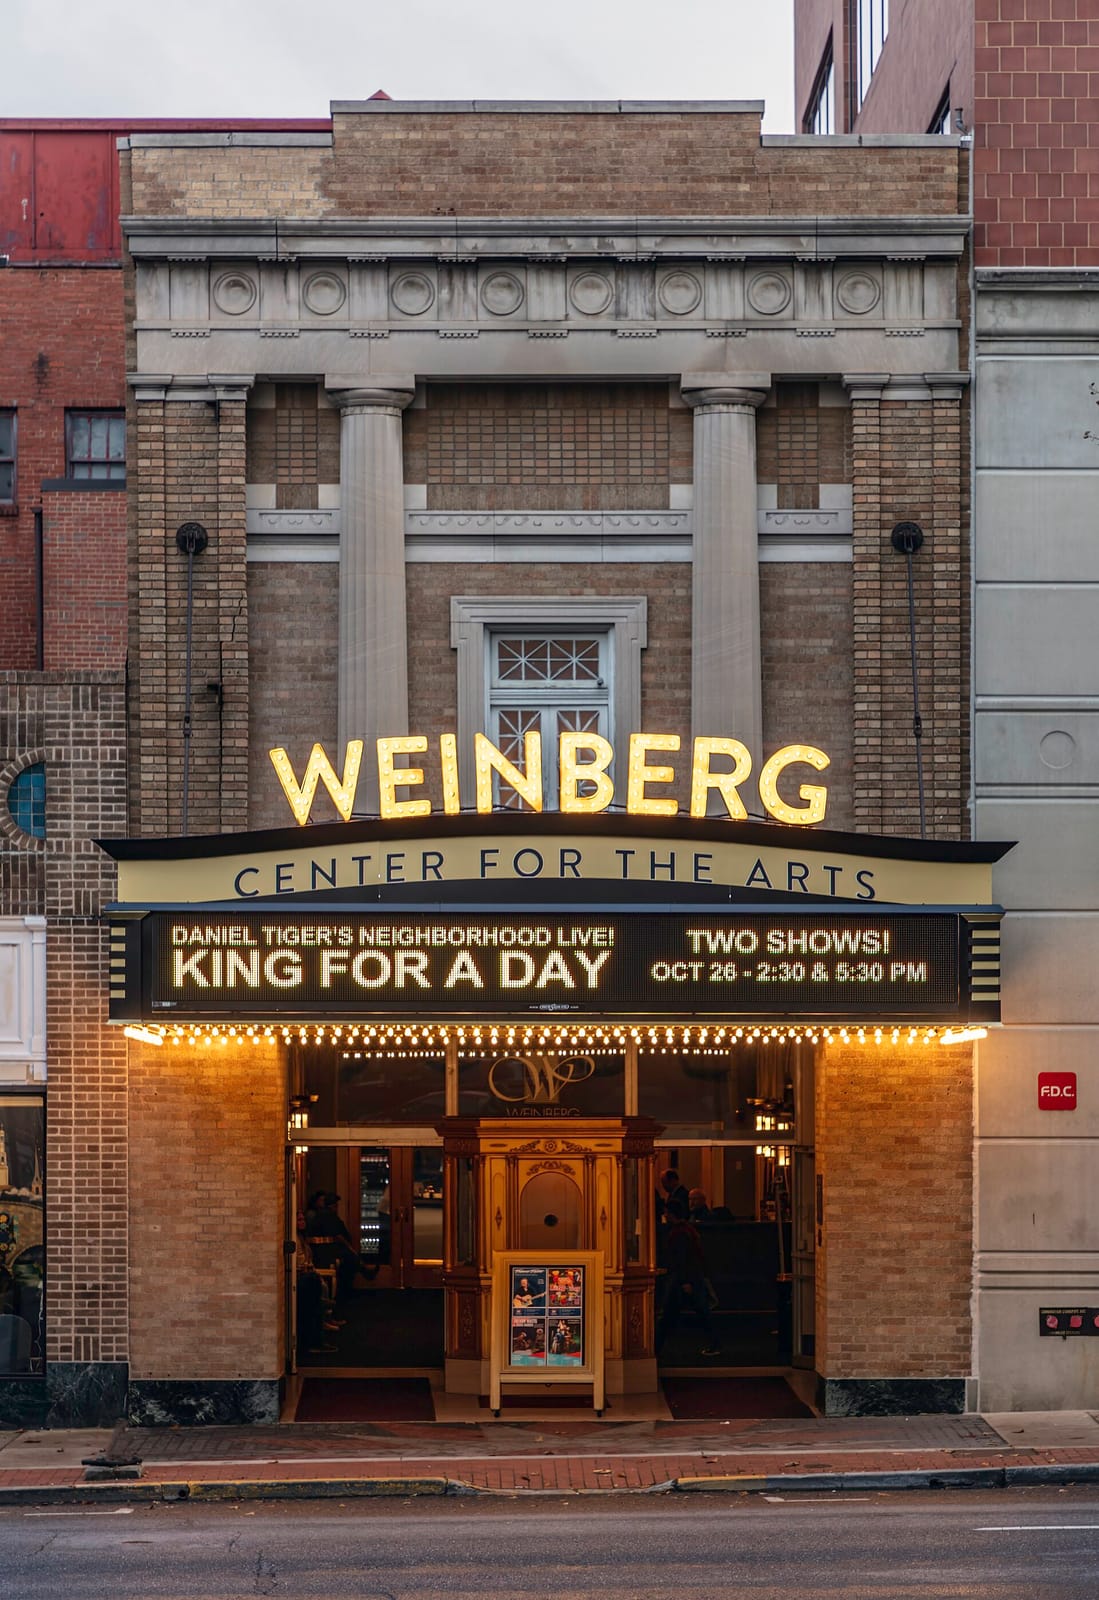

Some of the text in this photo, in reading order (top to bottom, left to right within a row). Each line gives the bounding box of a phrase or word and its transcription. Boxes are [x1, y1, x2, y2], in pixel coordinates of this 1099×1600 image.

[269, 731, 831, 826] WEINBERG
[234, 847, 875, 901] CENTER FOR THE ARTS
[171, 925, 615, 947] DANIEL TIGER'S NEIGHBORHOOD LIVE!
[686, 929, 890, 954] TWO SHOWS!
[173, 949, 612, 989] KING FOR A DAY
[651, 961, 705, 982] OCT
[756, 961, 806, 982] 2:30
[811, 961, 829, 982] &
[835, 961, 884, 982] 5:30
[890, 961, 928, 982] PM
[1040, 1085, 1075, 1097] F.D.C.
